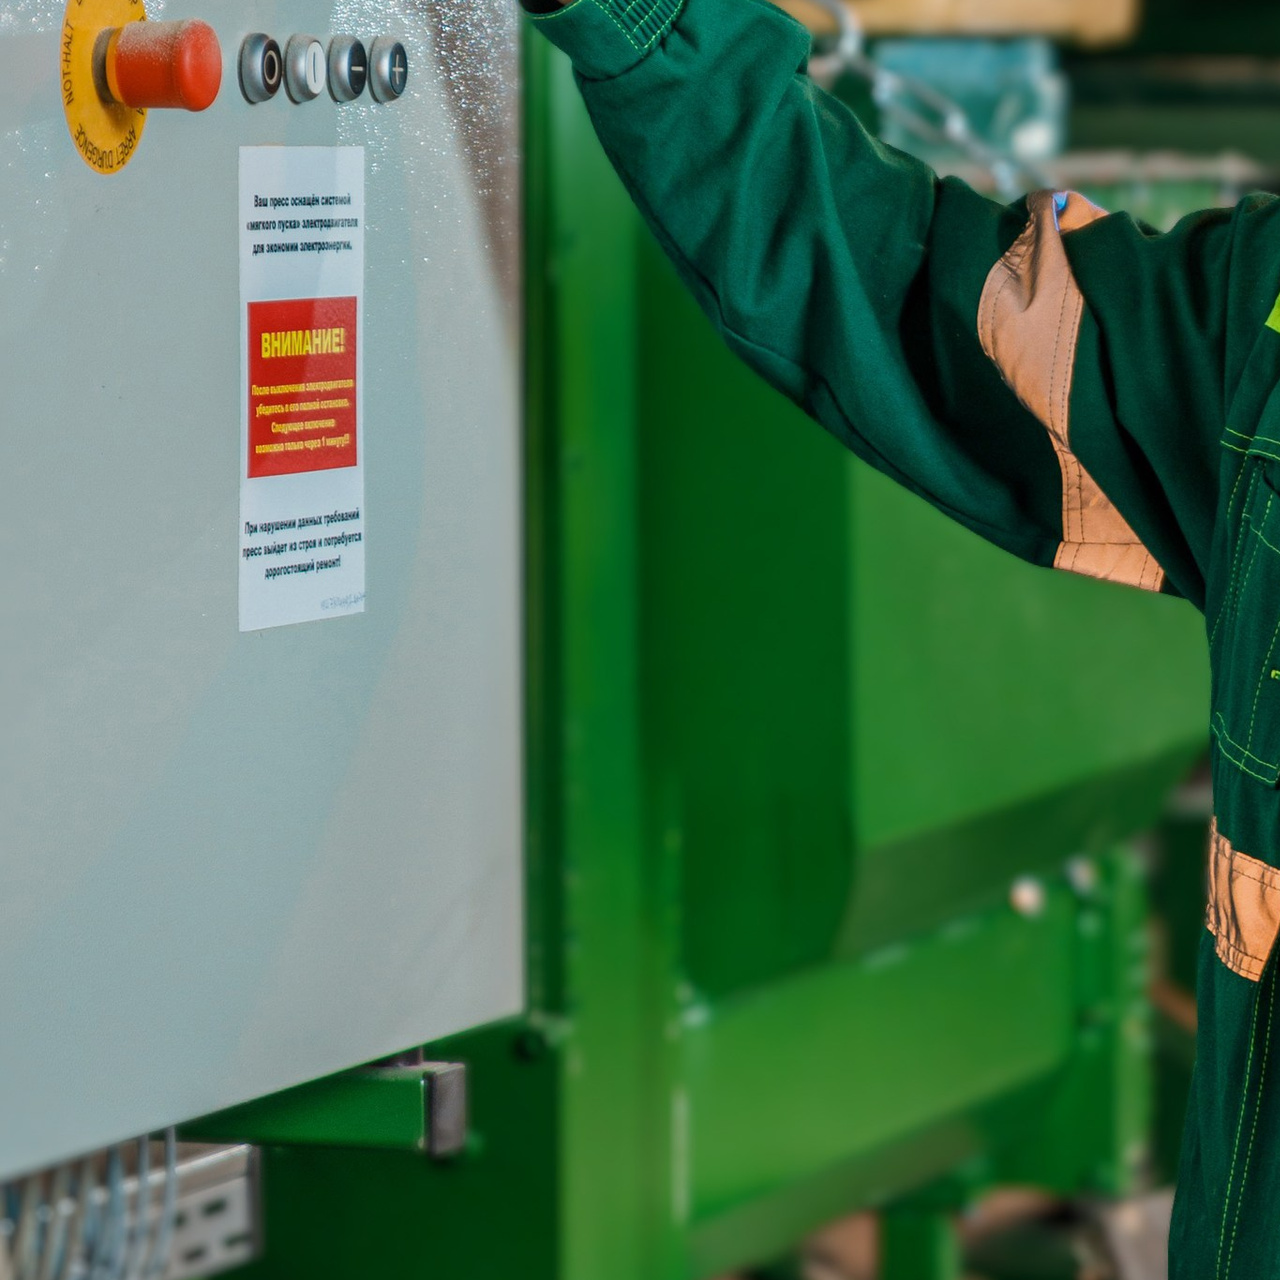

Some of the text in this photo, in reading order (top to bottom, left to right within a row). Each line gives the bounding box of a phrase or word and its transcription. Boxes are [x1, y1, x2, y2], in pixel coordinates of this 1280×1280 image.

[62, 18, 75, 107] NOT-HALT
[254, 195, 268, 207] Ваш
[270, 196, 289, 209] пресс
[252, 243, 264, 256] для
[266, 242, 298, 253] экономии
[261, 328, 345, 358] ВНИМАНИЕ!
[245, 507, 360, 536] При нарушении данных требований
[242, 547, 262, 560] пресс
[263, 541, 287, 555] выйдет
[289, 542, 297, 551] из
[299, 539, 317, 552] строя
[323, 531, 362, 547] потребуется
